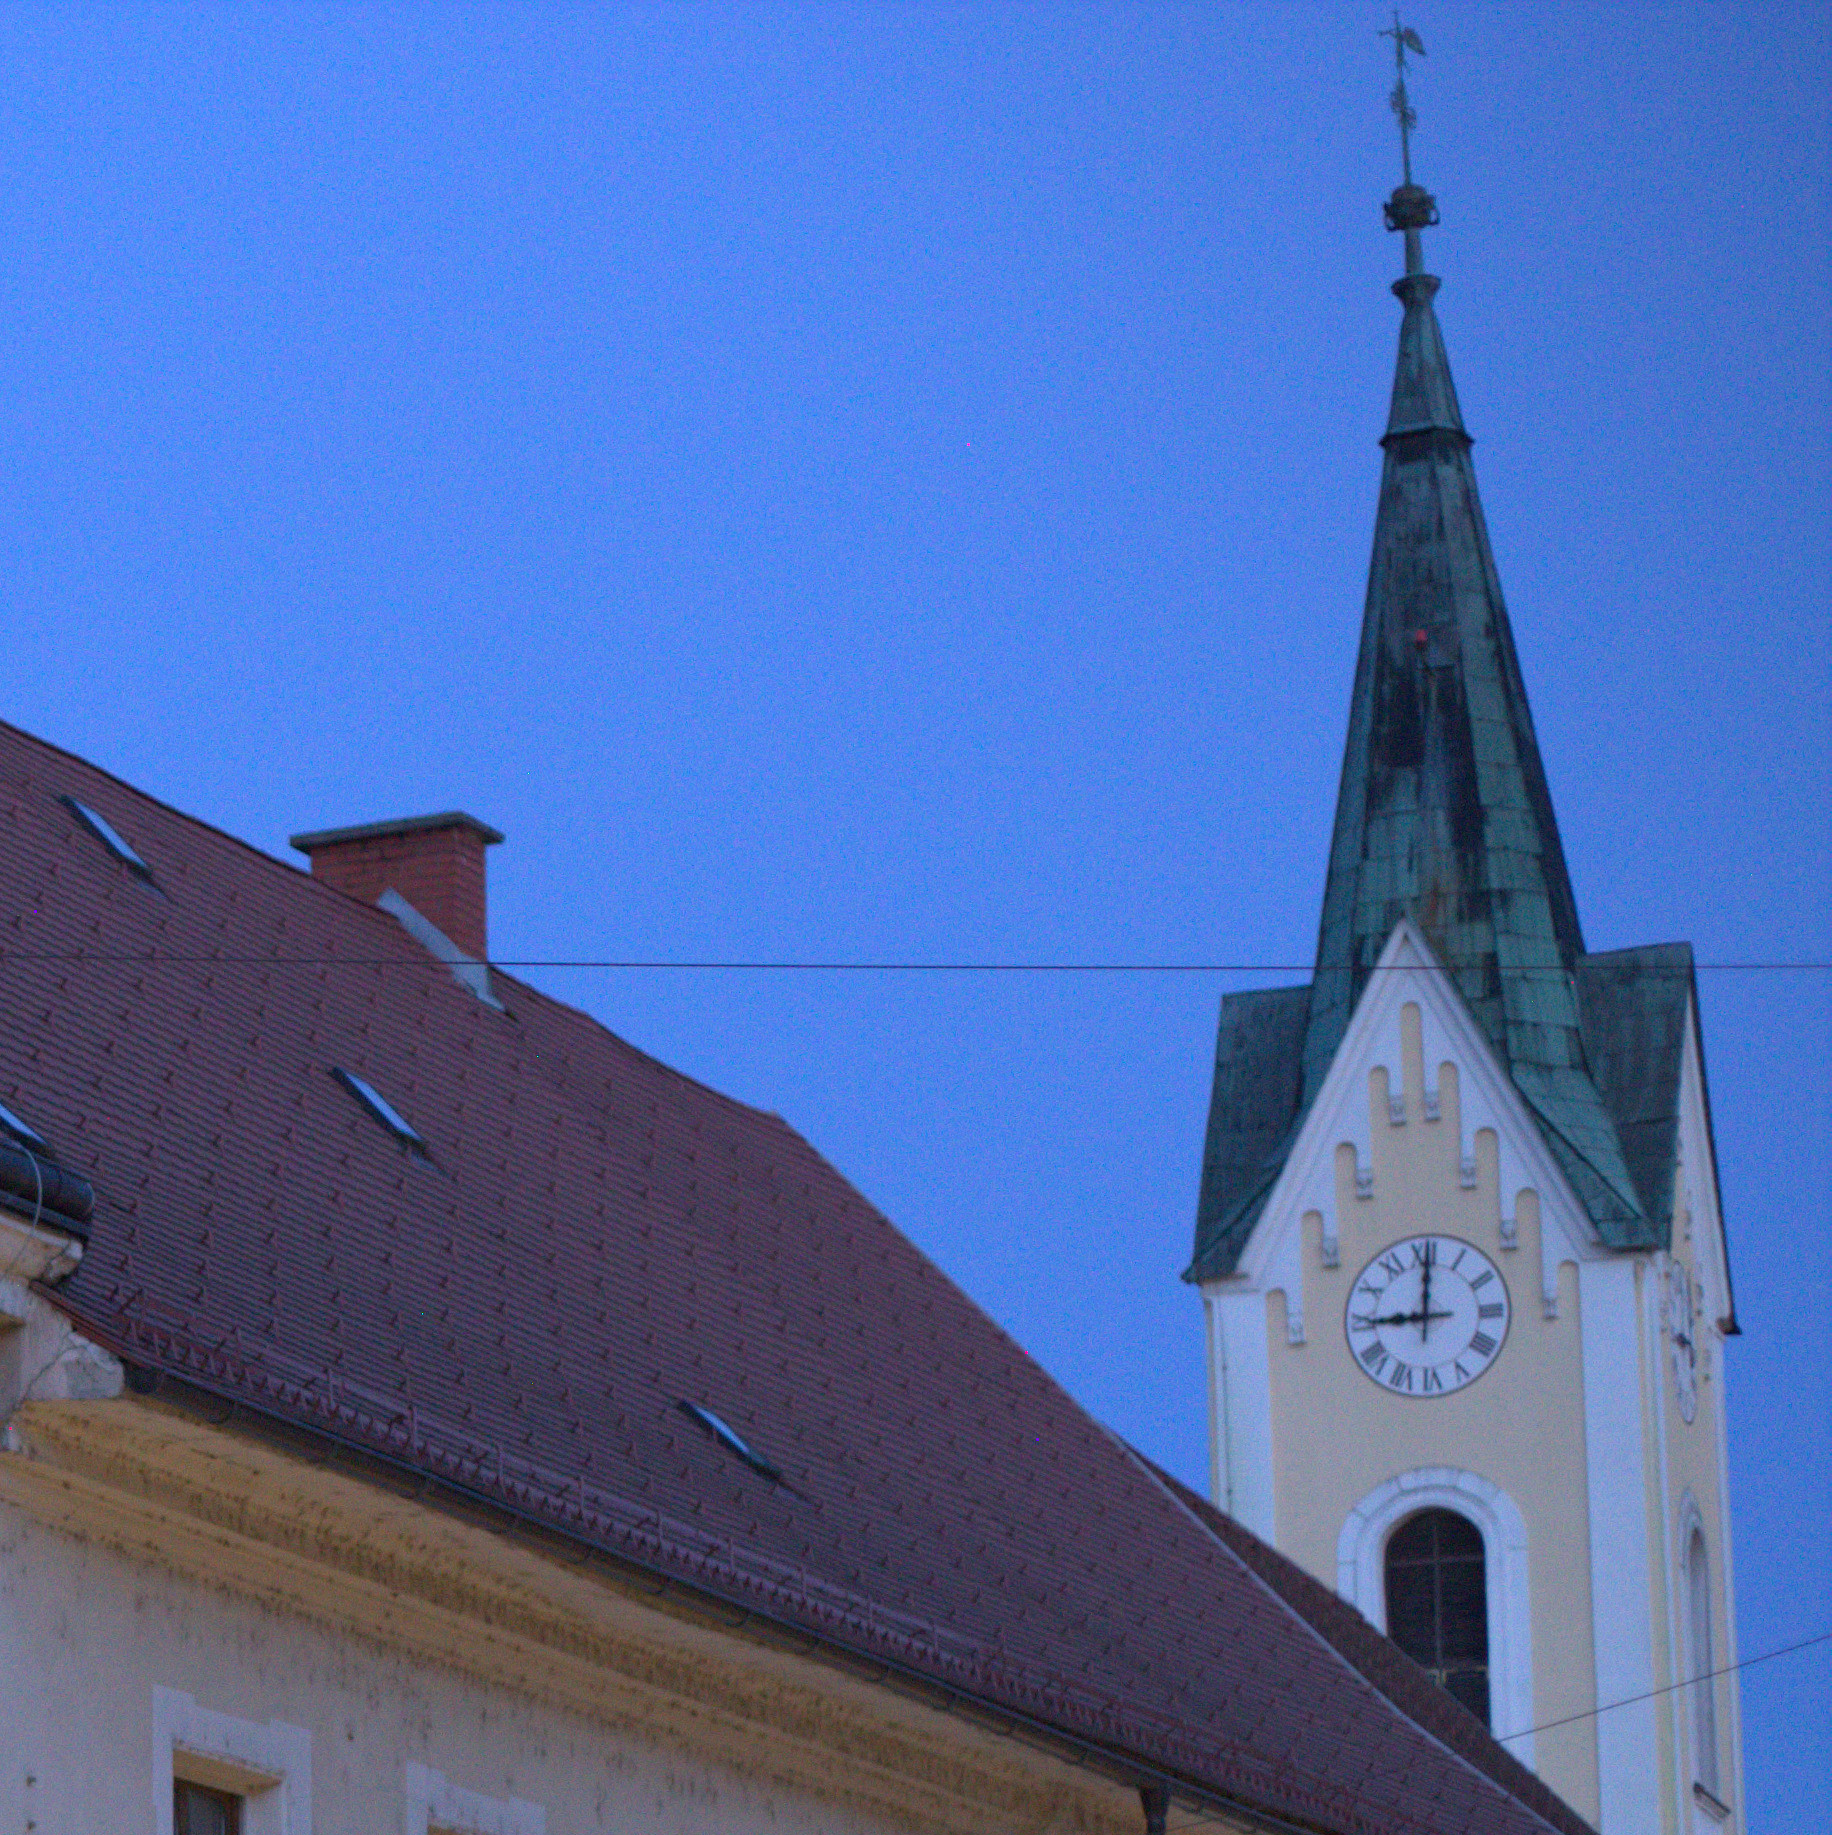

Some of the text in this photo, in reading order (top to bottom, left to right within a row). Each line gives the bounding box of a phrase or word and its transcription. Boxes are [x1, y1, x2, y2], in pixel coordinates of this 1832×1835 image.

[1411, 1241, 1436, 1267] XI
[1378, 1252, 1405, 1282] XI
[1358, 1280, 1384, 1300] X
[1454, 1361, 1470, 1382] V
